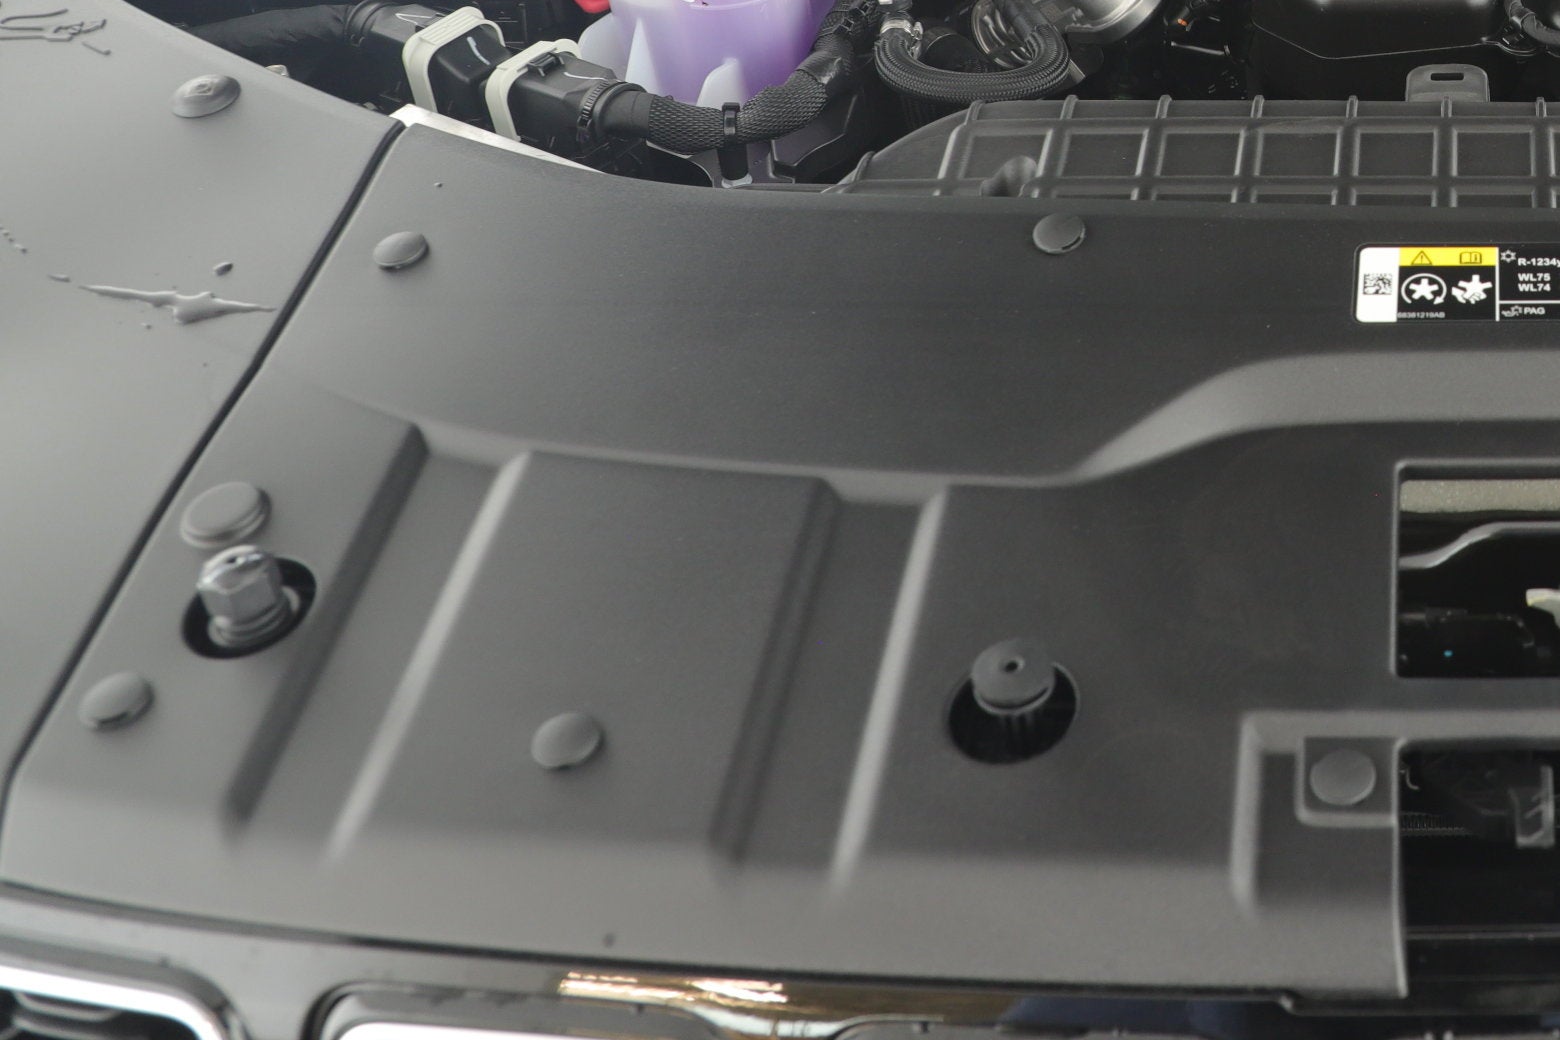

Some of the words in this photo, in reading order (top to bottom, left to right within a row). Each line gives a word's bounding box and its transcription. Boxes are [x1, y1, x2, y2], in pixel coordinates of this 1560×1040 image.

[1518, 273, 1551, 282] WL75
[1518, 283, 1551, 292] WL74
[1523, 306, 1546, 315] PAG
